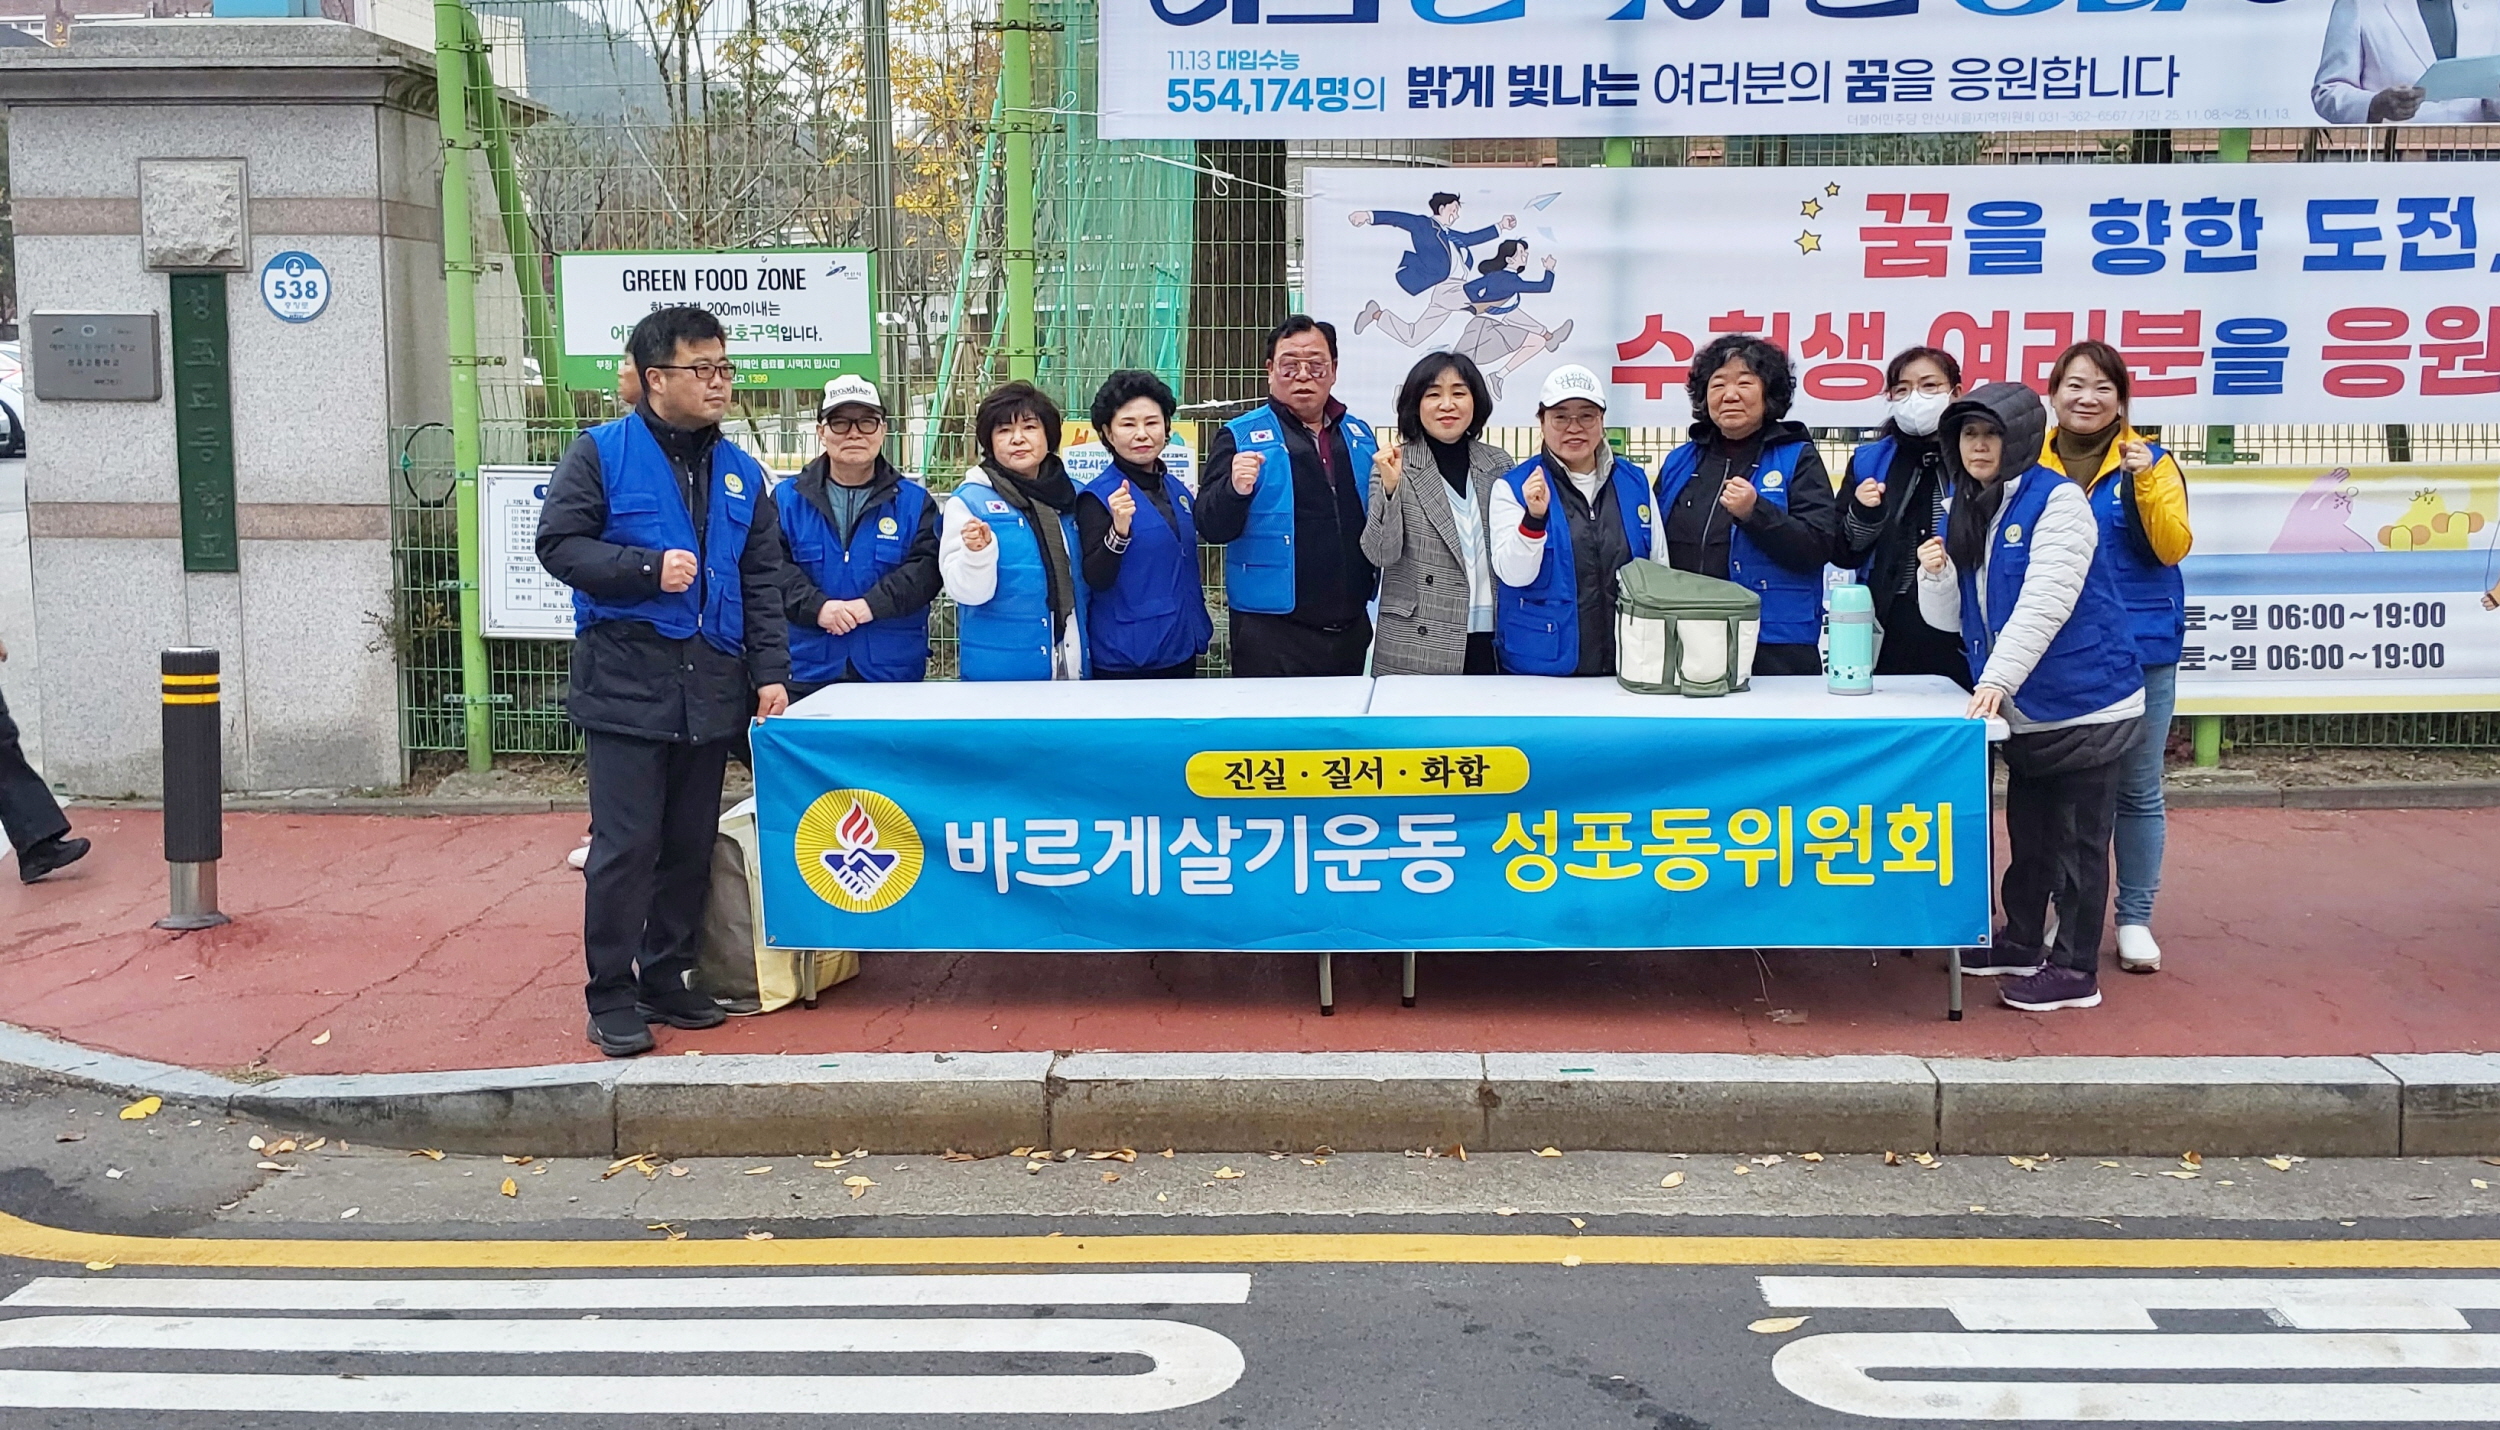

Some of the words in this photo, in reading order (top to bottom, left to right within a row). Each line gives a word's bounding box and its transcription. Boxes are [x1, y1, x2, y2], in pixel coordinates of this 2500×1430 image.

[1167, 50, 1211, 70] 11.13
[1216, 49, 1301, 72] 대입수능
[1166, 77, 1386, 116] 554,174명의
[1407, 65, 1497, 110] 밝게
[1508, 62, 1641, 108] 빛나는
[1653, 60, 1829, 106] 여러분의
[1845, 57, 1937, 105] 꿈을
[1948, 54, 2181, 101] 응원합니다
[1847, 113, 1917, 126] 더불어민주당
[1859, 193, 2046, 278] 꿈을
[2088, 195, 2264, 275] 향한
[274, 280, 319, 300] 538
[622, 268, 686, 291] GREEN
[695, 268, 748, 291] FOOD
[757, 268, 807, 291] ZONE
[706, 300, 781, 317] 200m이내는
[930, 310, 948, 323] 自由
[2267, 602, 2446, 631] 06:00~19:00
[2266, 642, 2445, 671] 06:00~19:00
[1223, 757, 1287, 792] 진실
[1321, 754, 1385, 790] 질서
[1418, 747, 1491, 789] 화합
[944, 813, 1467, 896] 바르게살기운동
[1490, 801, 1955, 893] 성포동위원회
